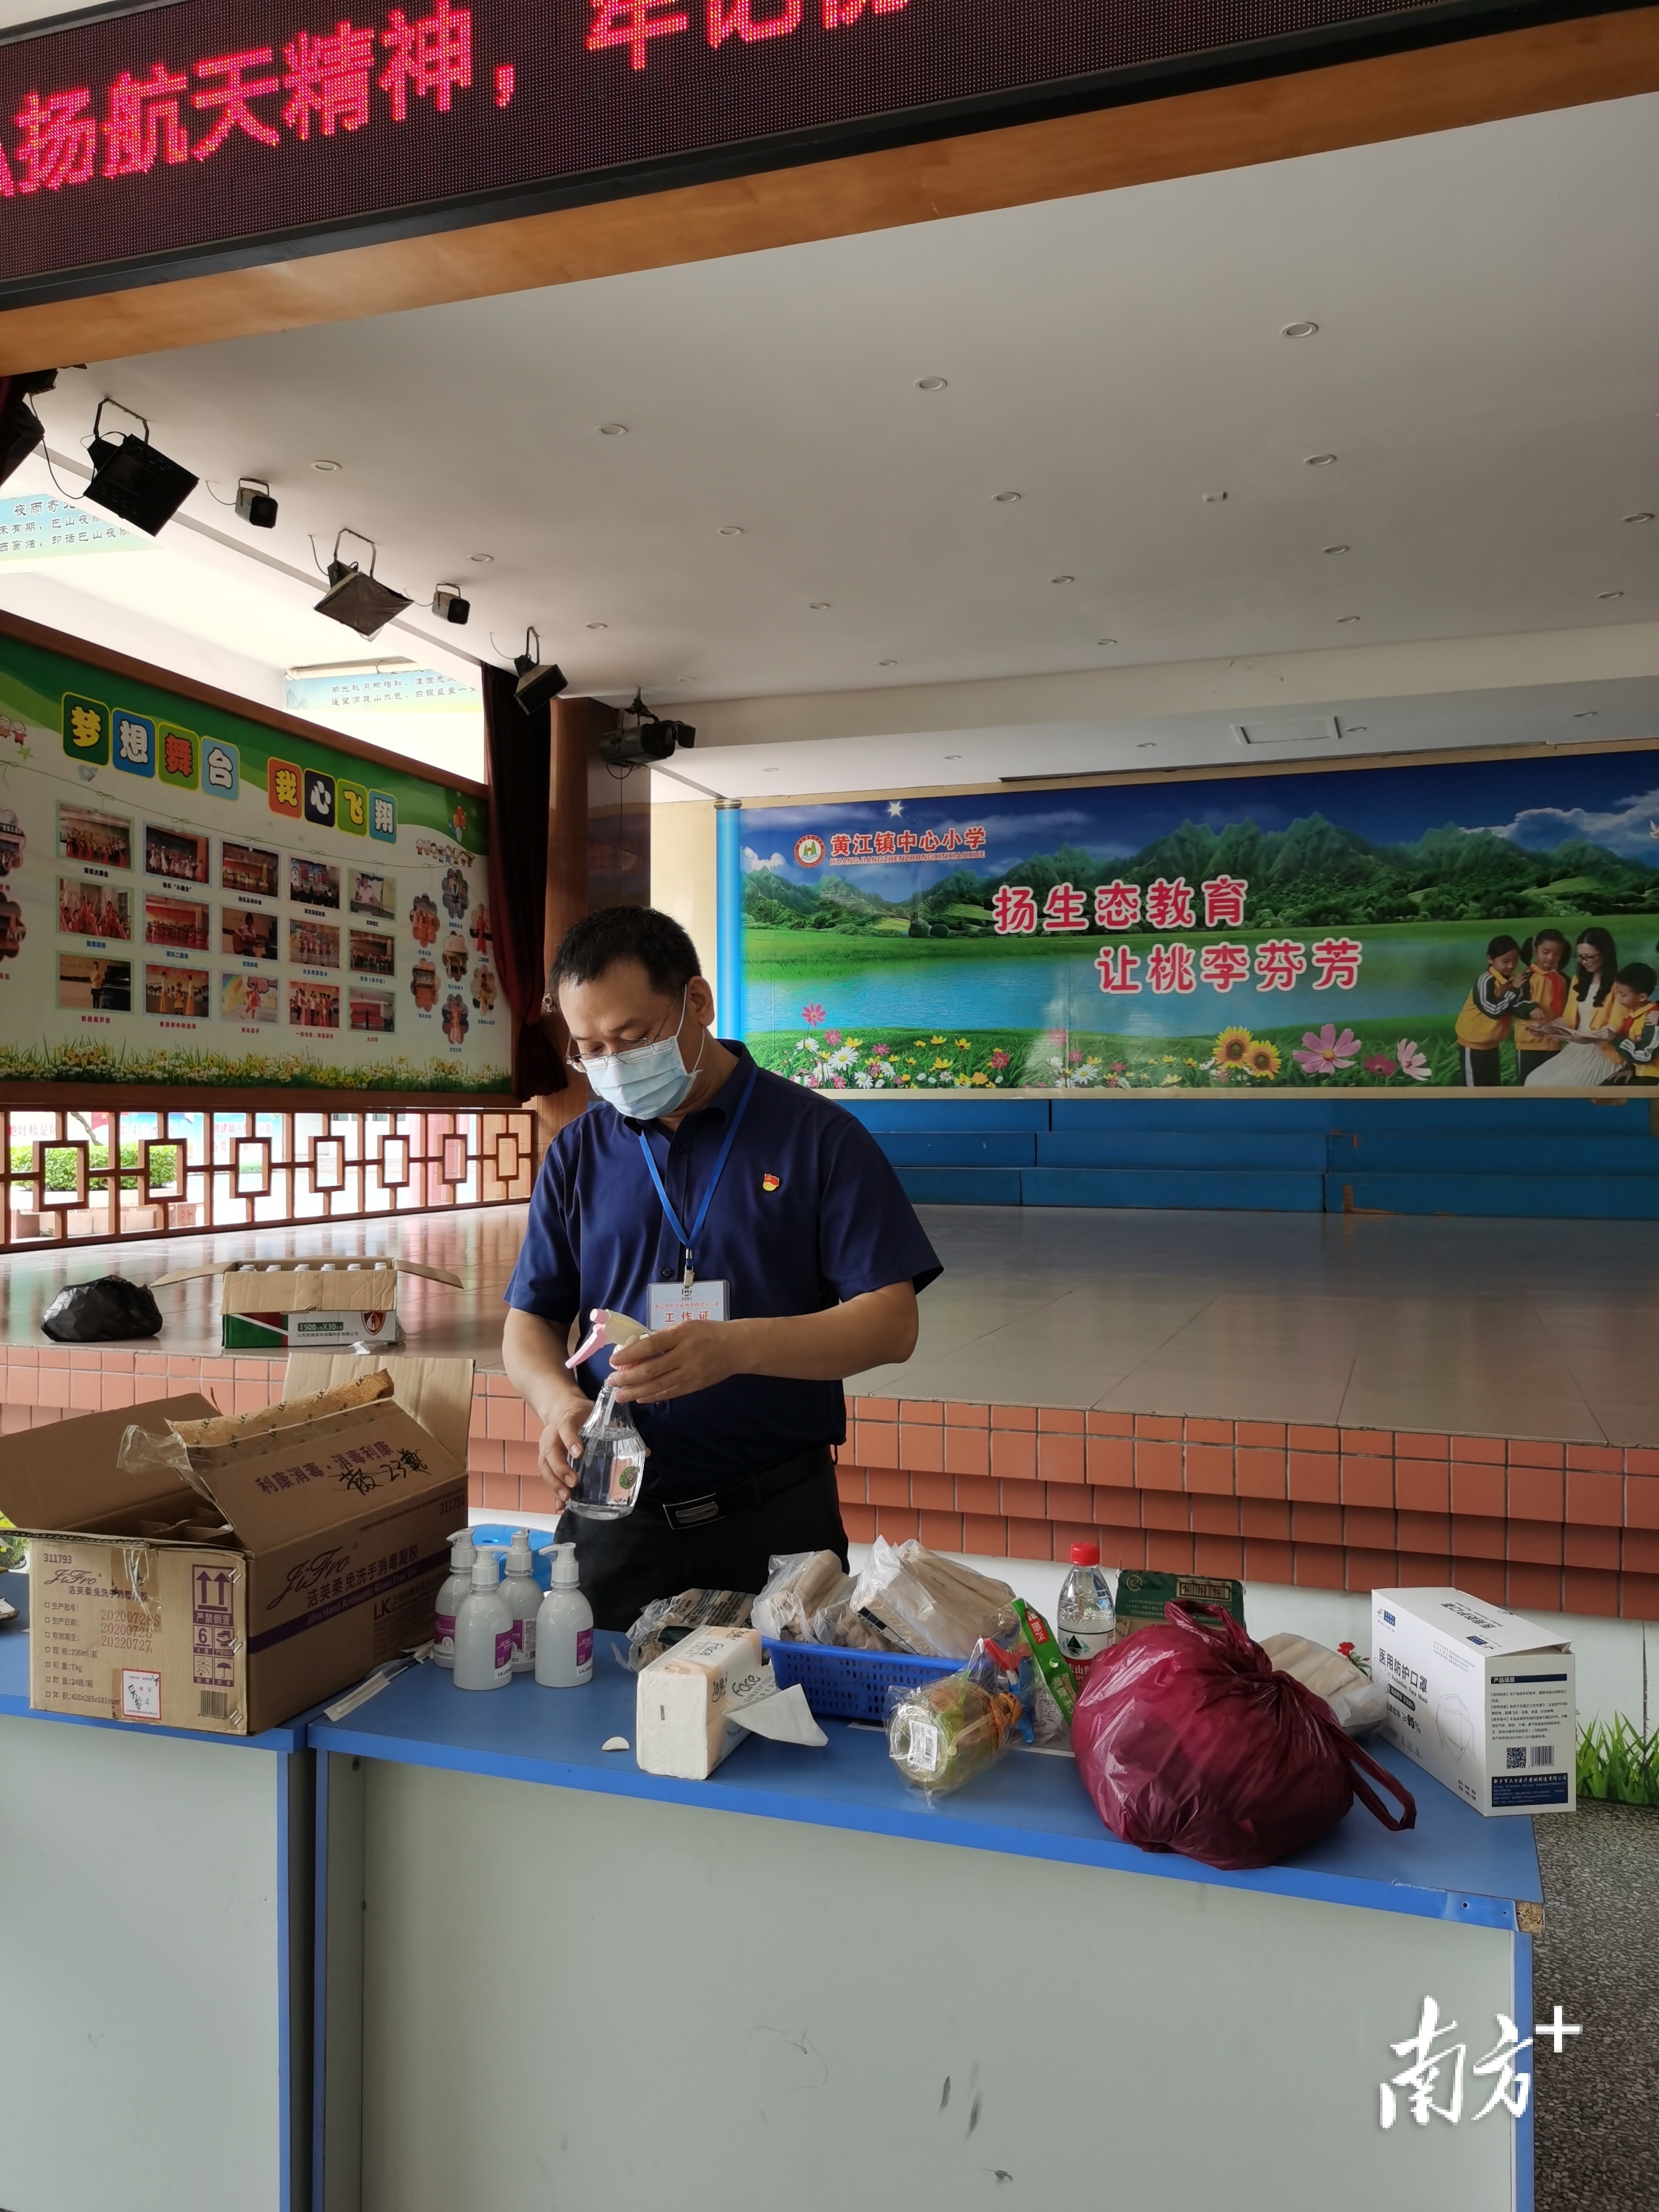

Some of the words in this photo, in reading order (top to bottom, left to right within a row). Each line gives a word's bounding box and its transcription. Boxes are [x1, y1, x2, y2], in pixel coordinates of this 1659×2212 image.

[70, 706, 234, 789] 梦想舞台
[274, 769, 394, 835] 我心飞翔
[831, 826, 987, 856] 黄江镇中心小学
[830, 850, 986, 866] HUANGJIANGZHENZHONGXINXIAOXUE
[993, 875, 1248, 934] 扬生态教育
[1095, 939, 1362, 994] 让桃李芬芳
[664, 1310, 710, 1322] 工作证
[440, 1494, 465, 1515] 311793
[44, 1553, 72, 1564] 311793
[196, 1612, 230, 1626] 严禁倒置
[374, 1597, 392, 1621] LK
[198, 1627, 207, 1644] 6
[1031, 1621, 1046, 1642] 振兴
[700, 1643, 724, 1656] Face
[1379, 1647, 1427, 1693] 医用防护口罩
[732, 1675, 761, 1697] Face
[1402, 1711, 1421, 1734] ≥95%
